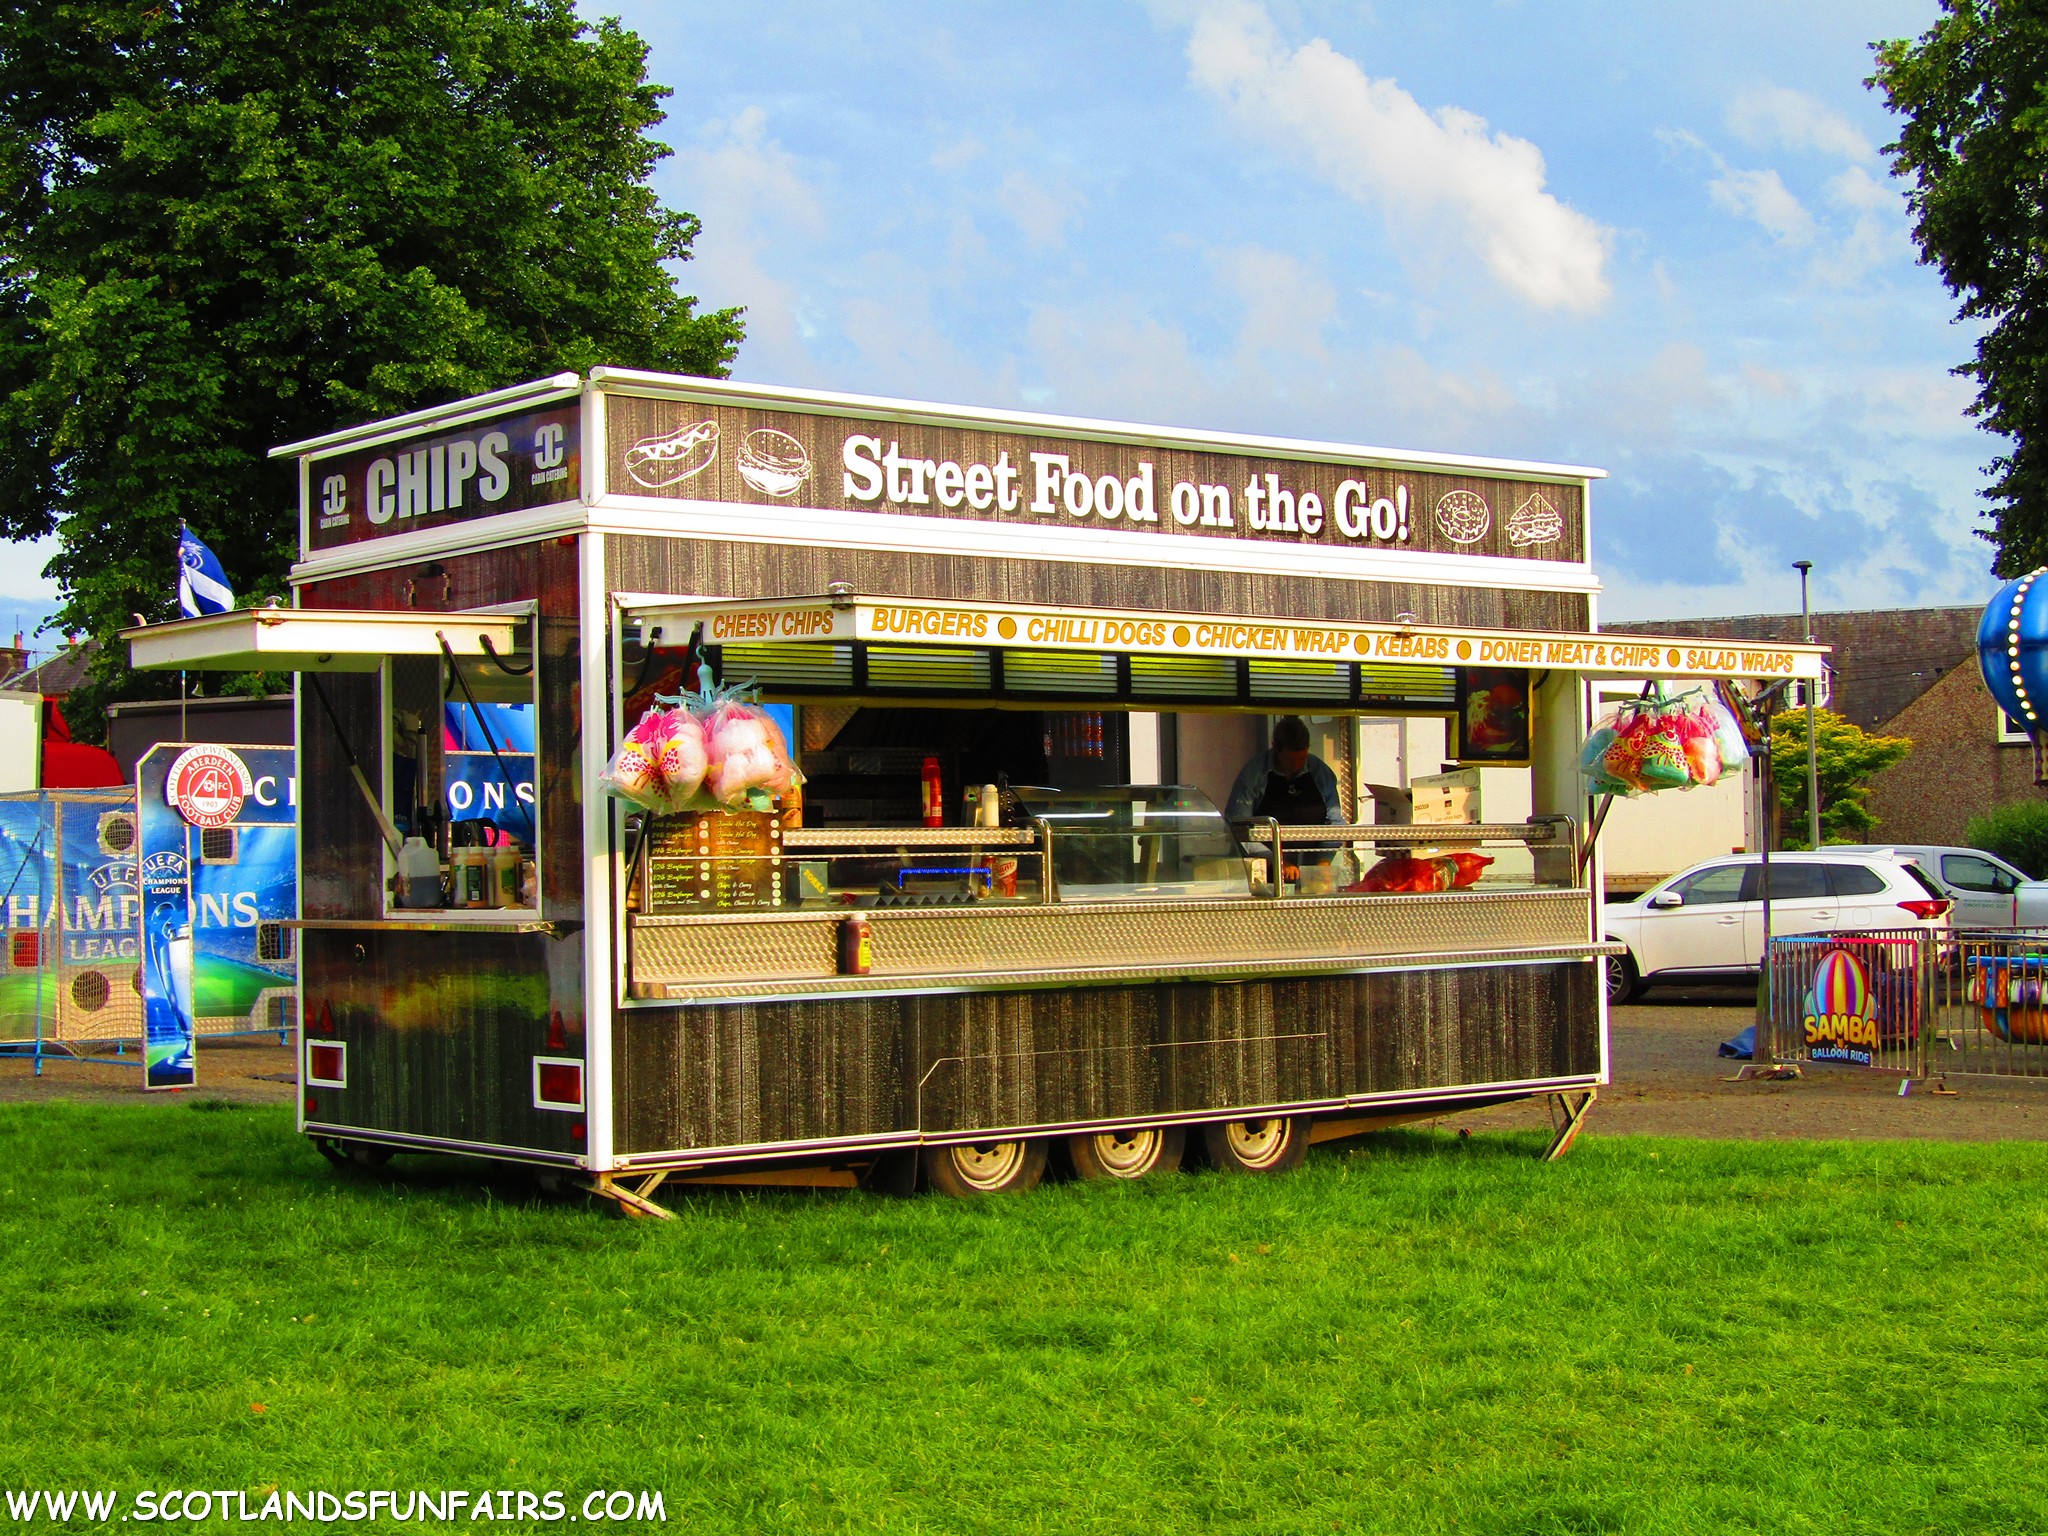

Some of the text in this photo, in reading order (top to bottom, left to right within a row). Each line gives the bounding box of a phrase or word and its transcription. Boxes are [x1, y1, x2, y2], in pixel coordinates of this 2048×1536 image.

[367, 432, 510, 524] CHIPS
[843, 434, 1409, 541] Street Food on the Go!
[712, 610, 834, 639] CHEESY CHIPS
[872, 608, 1793, 672] BURGERS CHILLI DOGS CHICKEN WRAP KEBABS DONER MEAT & CHIPS SALAD WRAPS
[169, 756, 190, 803] SCOTTISH
[190, 746, 208, 757] CUP
[210, 747, 247, 779] WINNERS
[188, 757, 235, 777] ABERDEEN
[218, 782, 229, 791] FC
[179, 794, 241, 826] FOOTBALL CLUB
[92, 866, 138, 888] UEF
[145, 855, 183, 872] UEFA
[142, 877, 188, 885] CHAMPIONS
[1804, 1013, 1878, 1049] SAMBA
[1811, 1046, 1869, 1063] BALLOON RIDE
